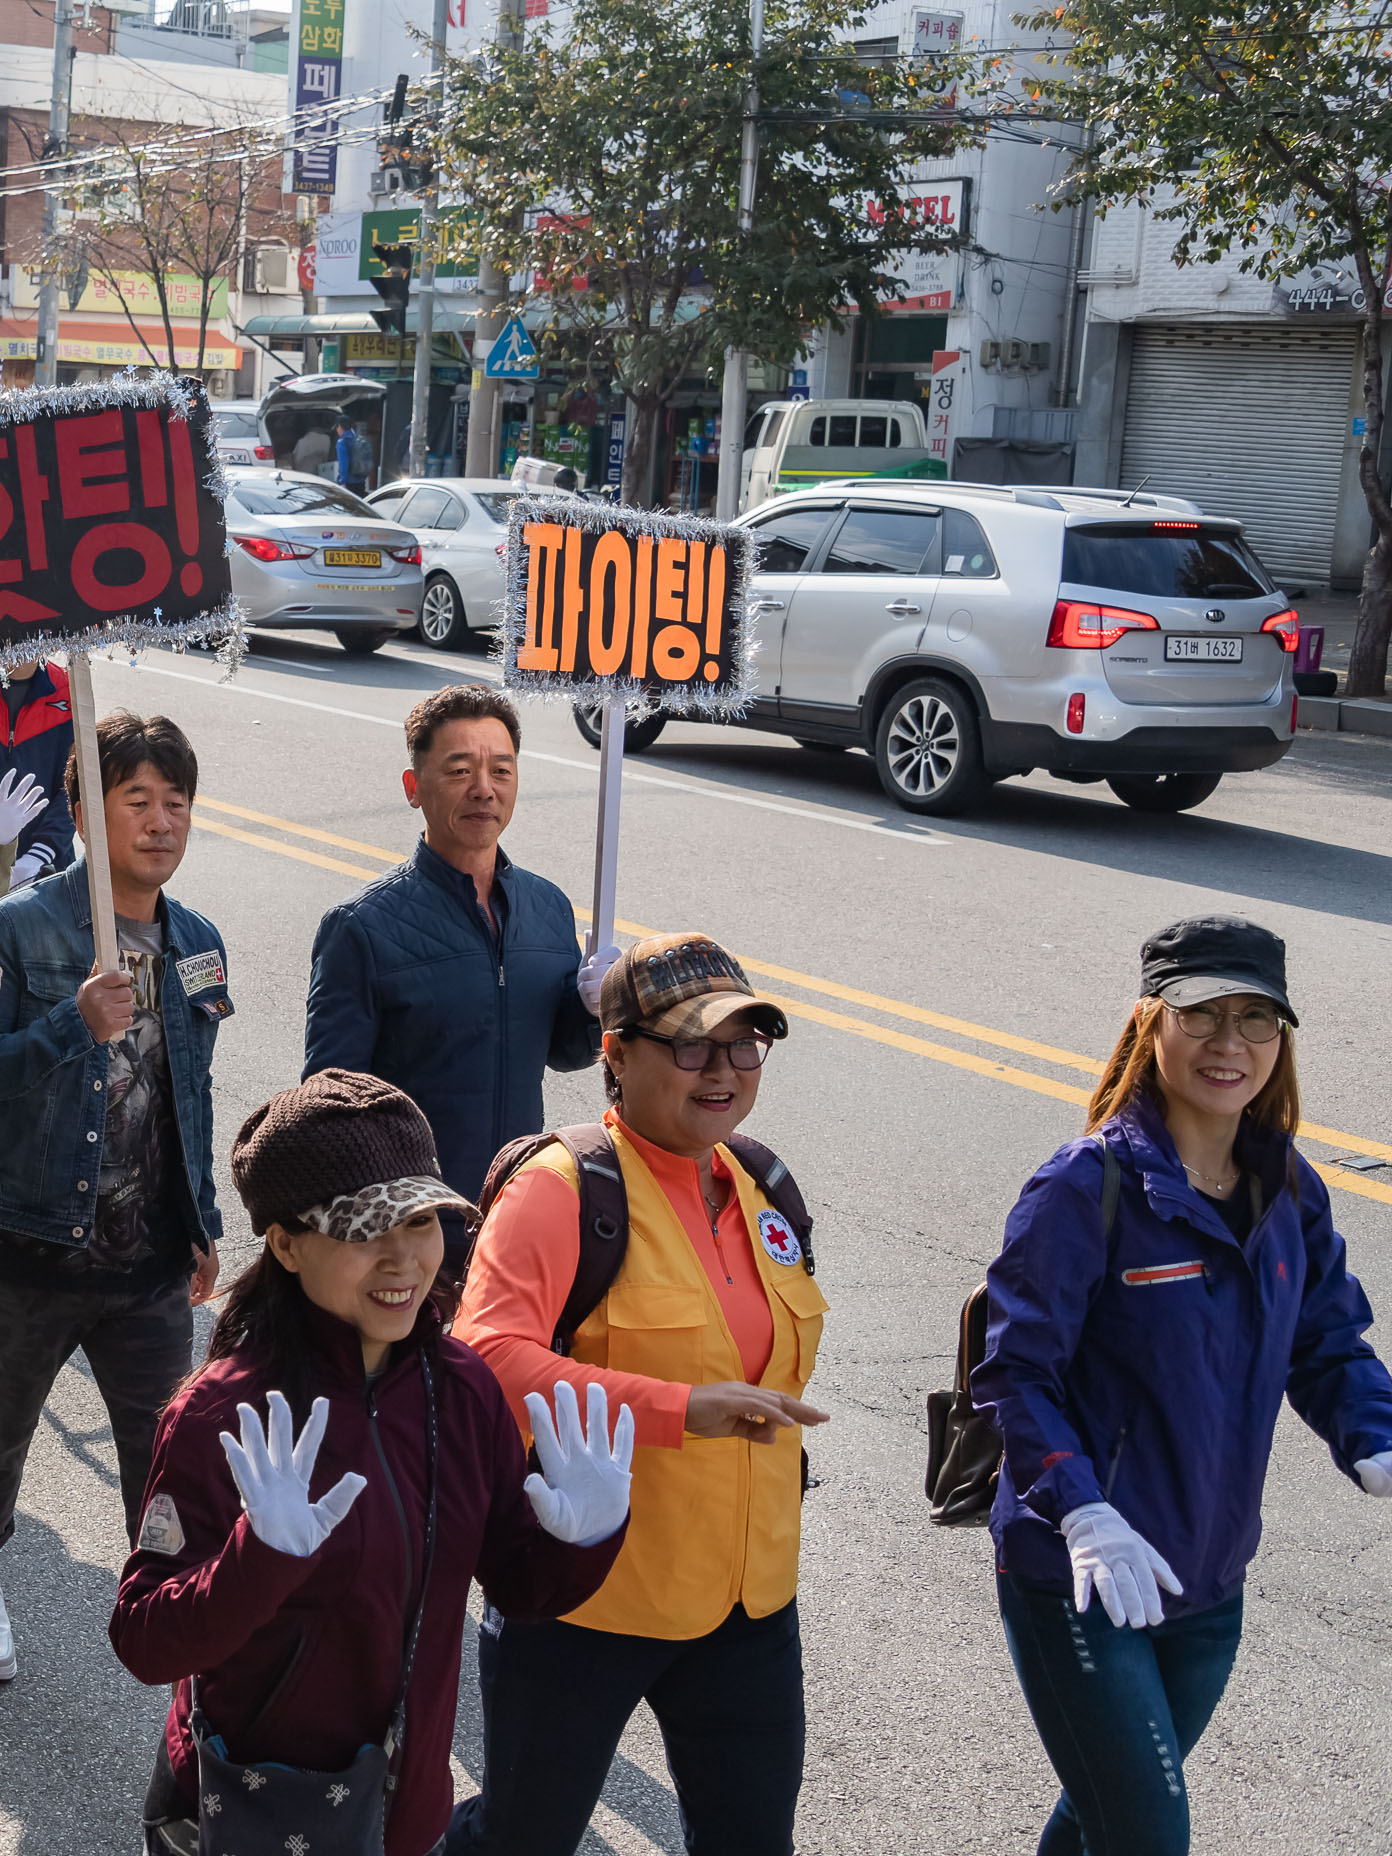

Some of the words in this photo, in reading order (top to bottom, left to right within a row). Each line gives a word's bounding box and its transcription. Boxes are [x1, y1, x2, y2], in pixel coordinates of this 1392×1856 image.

[301, 24, 343, 52] 삼화
[917, 18, 959, 40] 커피숍
[866, 195, 956, 226] MTEL
[317, 238, 357, 255] NOROO
[934, 377, 955, 410] 정
[609, 420, 625, 481] 페인트
[930, 413, 949, 459] 커피
[516, 521, 726, 683] 파이팅!
[1205, 640, 1236, 657] 1632
